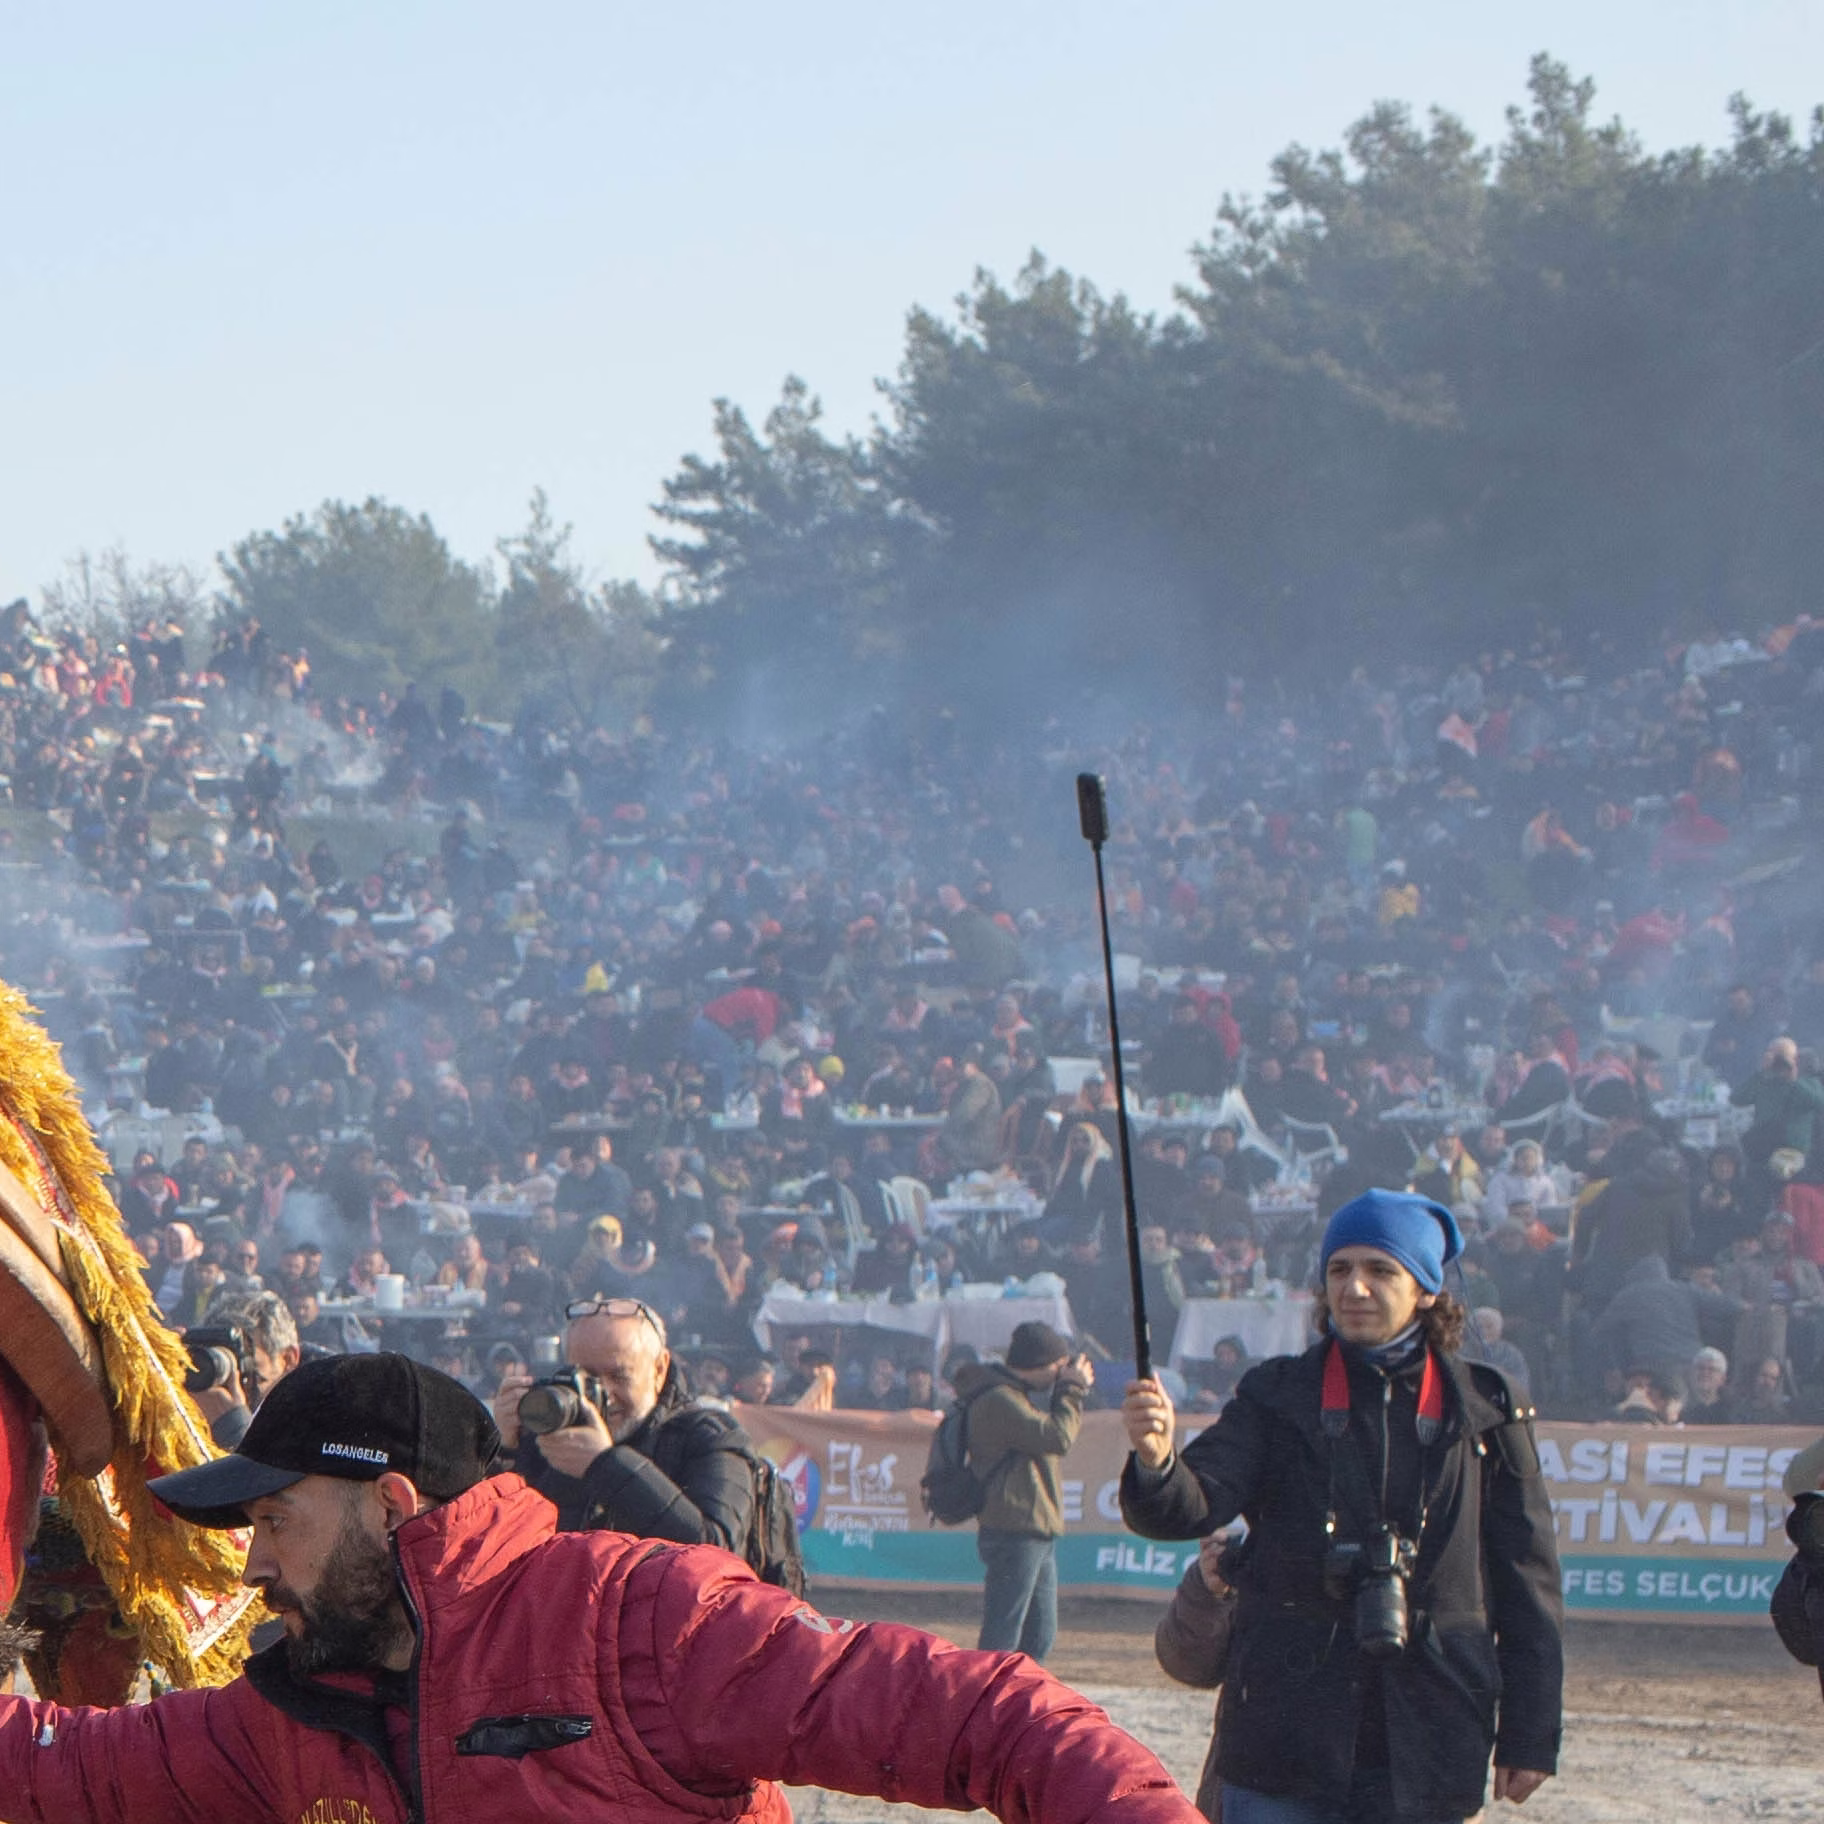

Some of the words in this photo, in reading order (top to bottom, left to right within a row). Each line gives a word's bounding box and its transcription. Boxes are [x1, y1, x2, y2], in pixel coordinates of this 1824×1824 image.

[1096, 1541, 1177, 1576] FİLİZ
[1562, 1570, 1626, 1597] FES
[1637, 1571, 1774, 1604] SELÇUK
